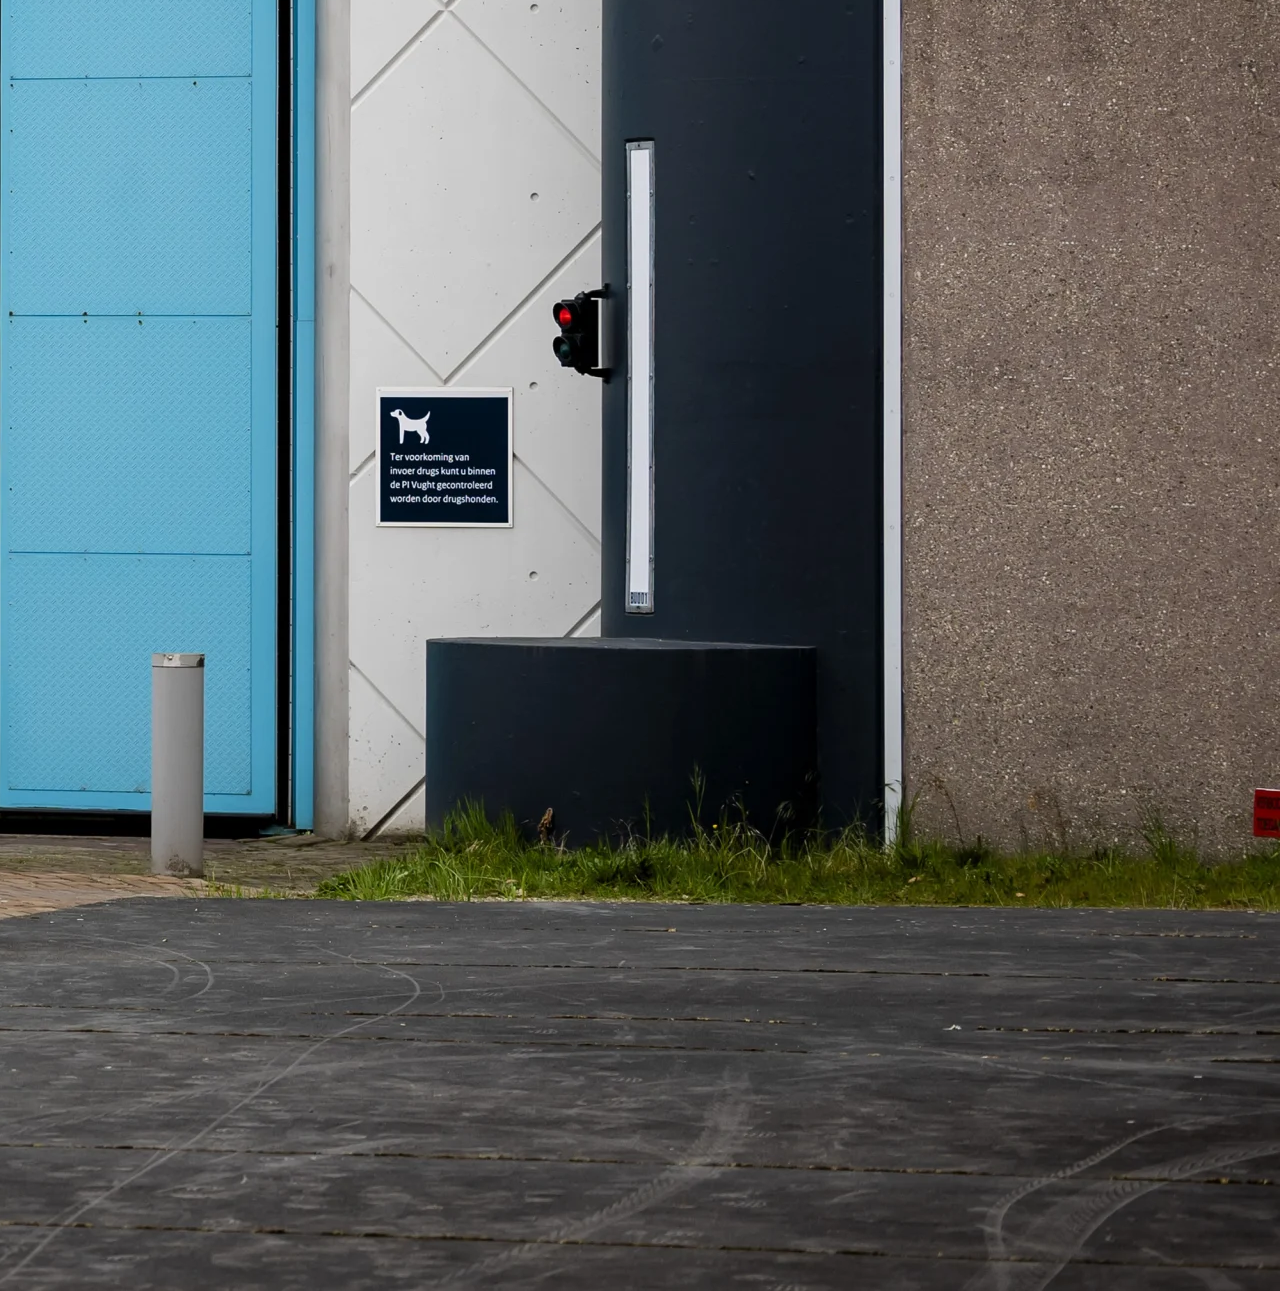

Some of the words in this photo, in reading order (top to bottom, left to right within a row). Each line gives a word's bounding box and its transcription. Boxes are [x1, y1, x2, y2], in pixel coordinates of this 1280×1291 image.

[390, 452, 403, 461] Ter
[404, 452, 453, 463] voorkoming
[390, 466, 415, 475] invoer
[417, 466, 439, 477] drugs
[441, 466, 459, 475] kunt
[468, 466, 496, 475] binnen
[390, 480, 400, 488] de
[402, 480, 409, 488] PI
[411, 480, 435, 491] Vught
[436, 480, 492, 491] gecontroleerd
[390, 494, 421, 503] worden
[422, 494, 441, 503] door
[443, 494, 498, 505] drugshonden.
